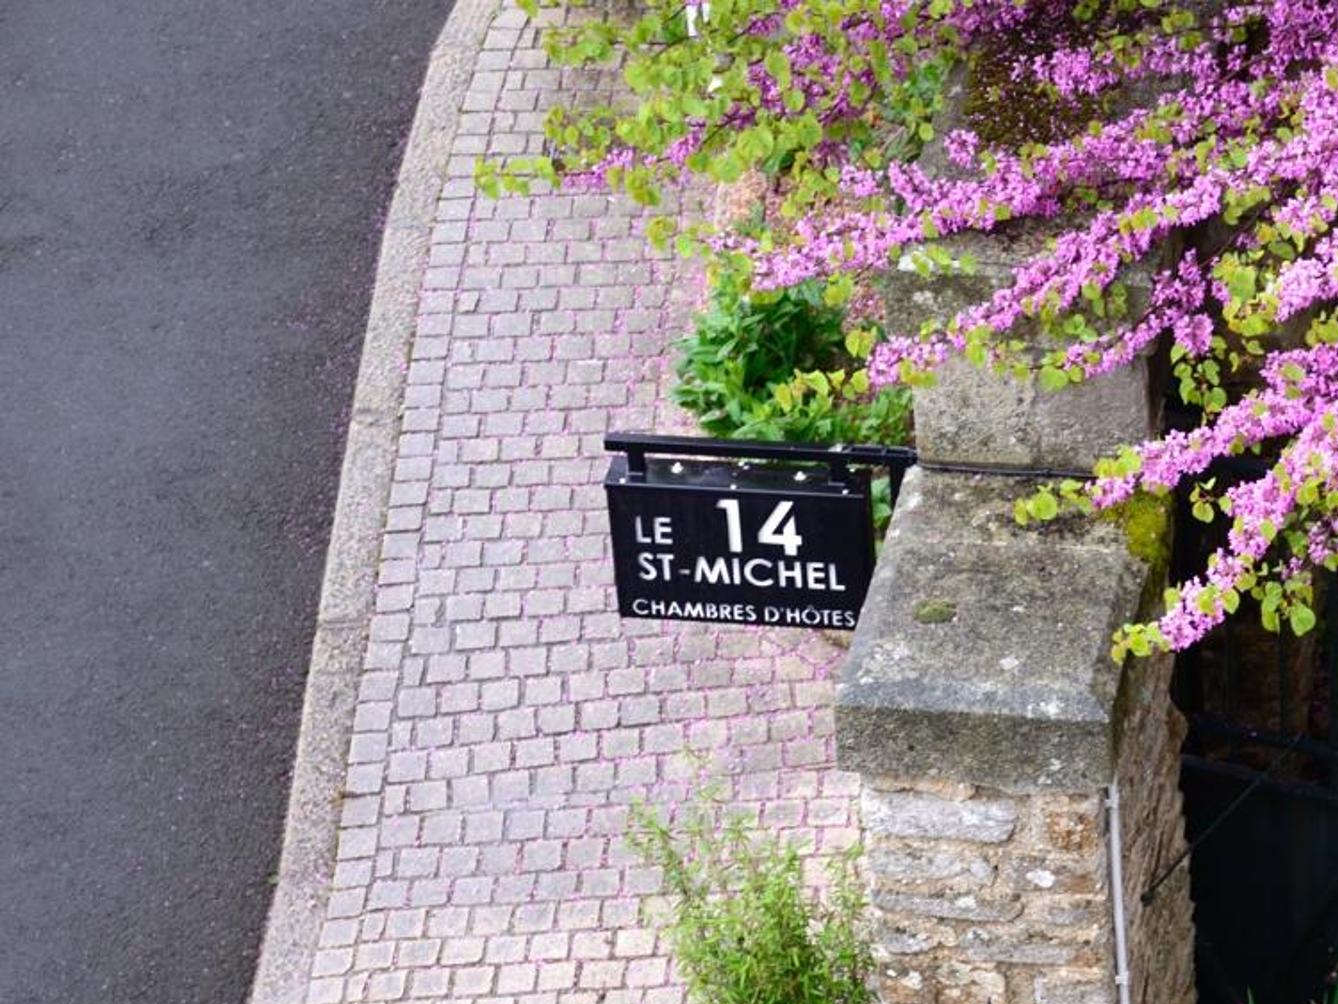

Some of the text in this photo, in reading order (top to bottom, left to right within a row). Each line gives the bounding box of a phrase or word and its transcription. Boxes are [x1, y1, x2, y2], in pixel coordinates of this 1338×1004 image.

[634, 498, 803, 556] LE 14
[638, 552, 847, 591] ST-MICHEL
[632, 599, 856, 628] CHAMBRES D'HÔTES
